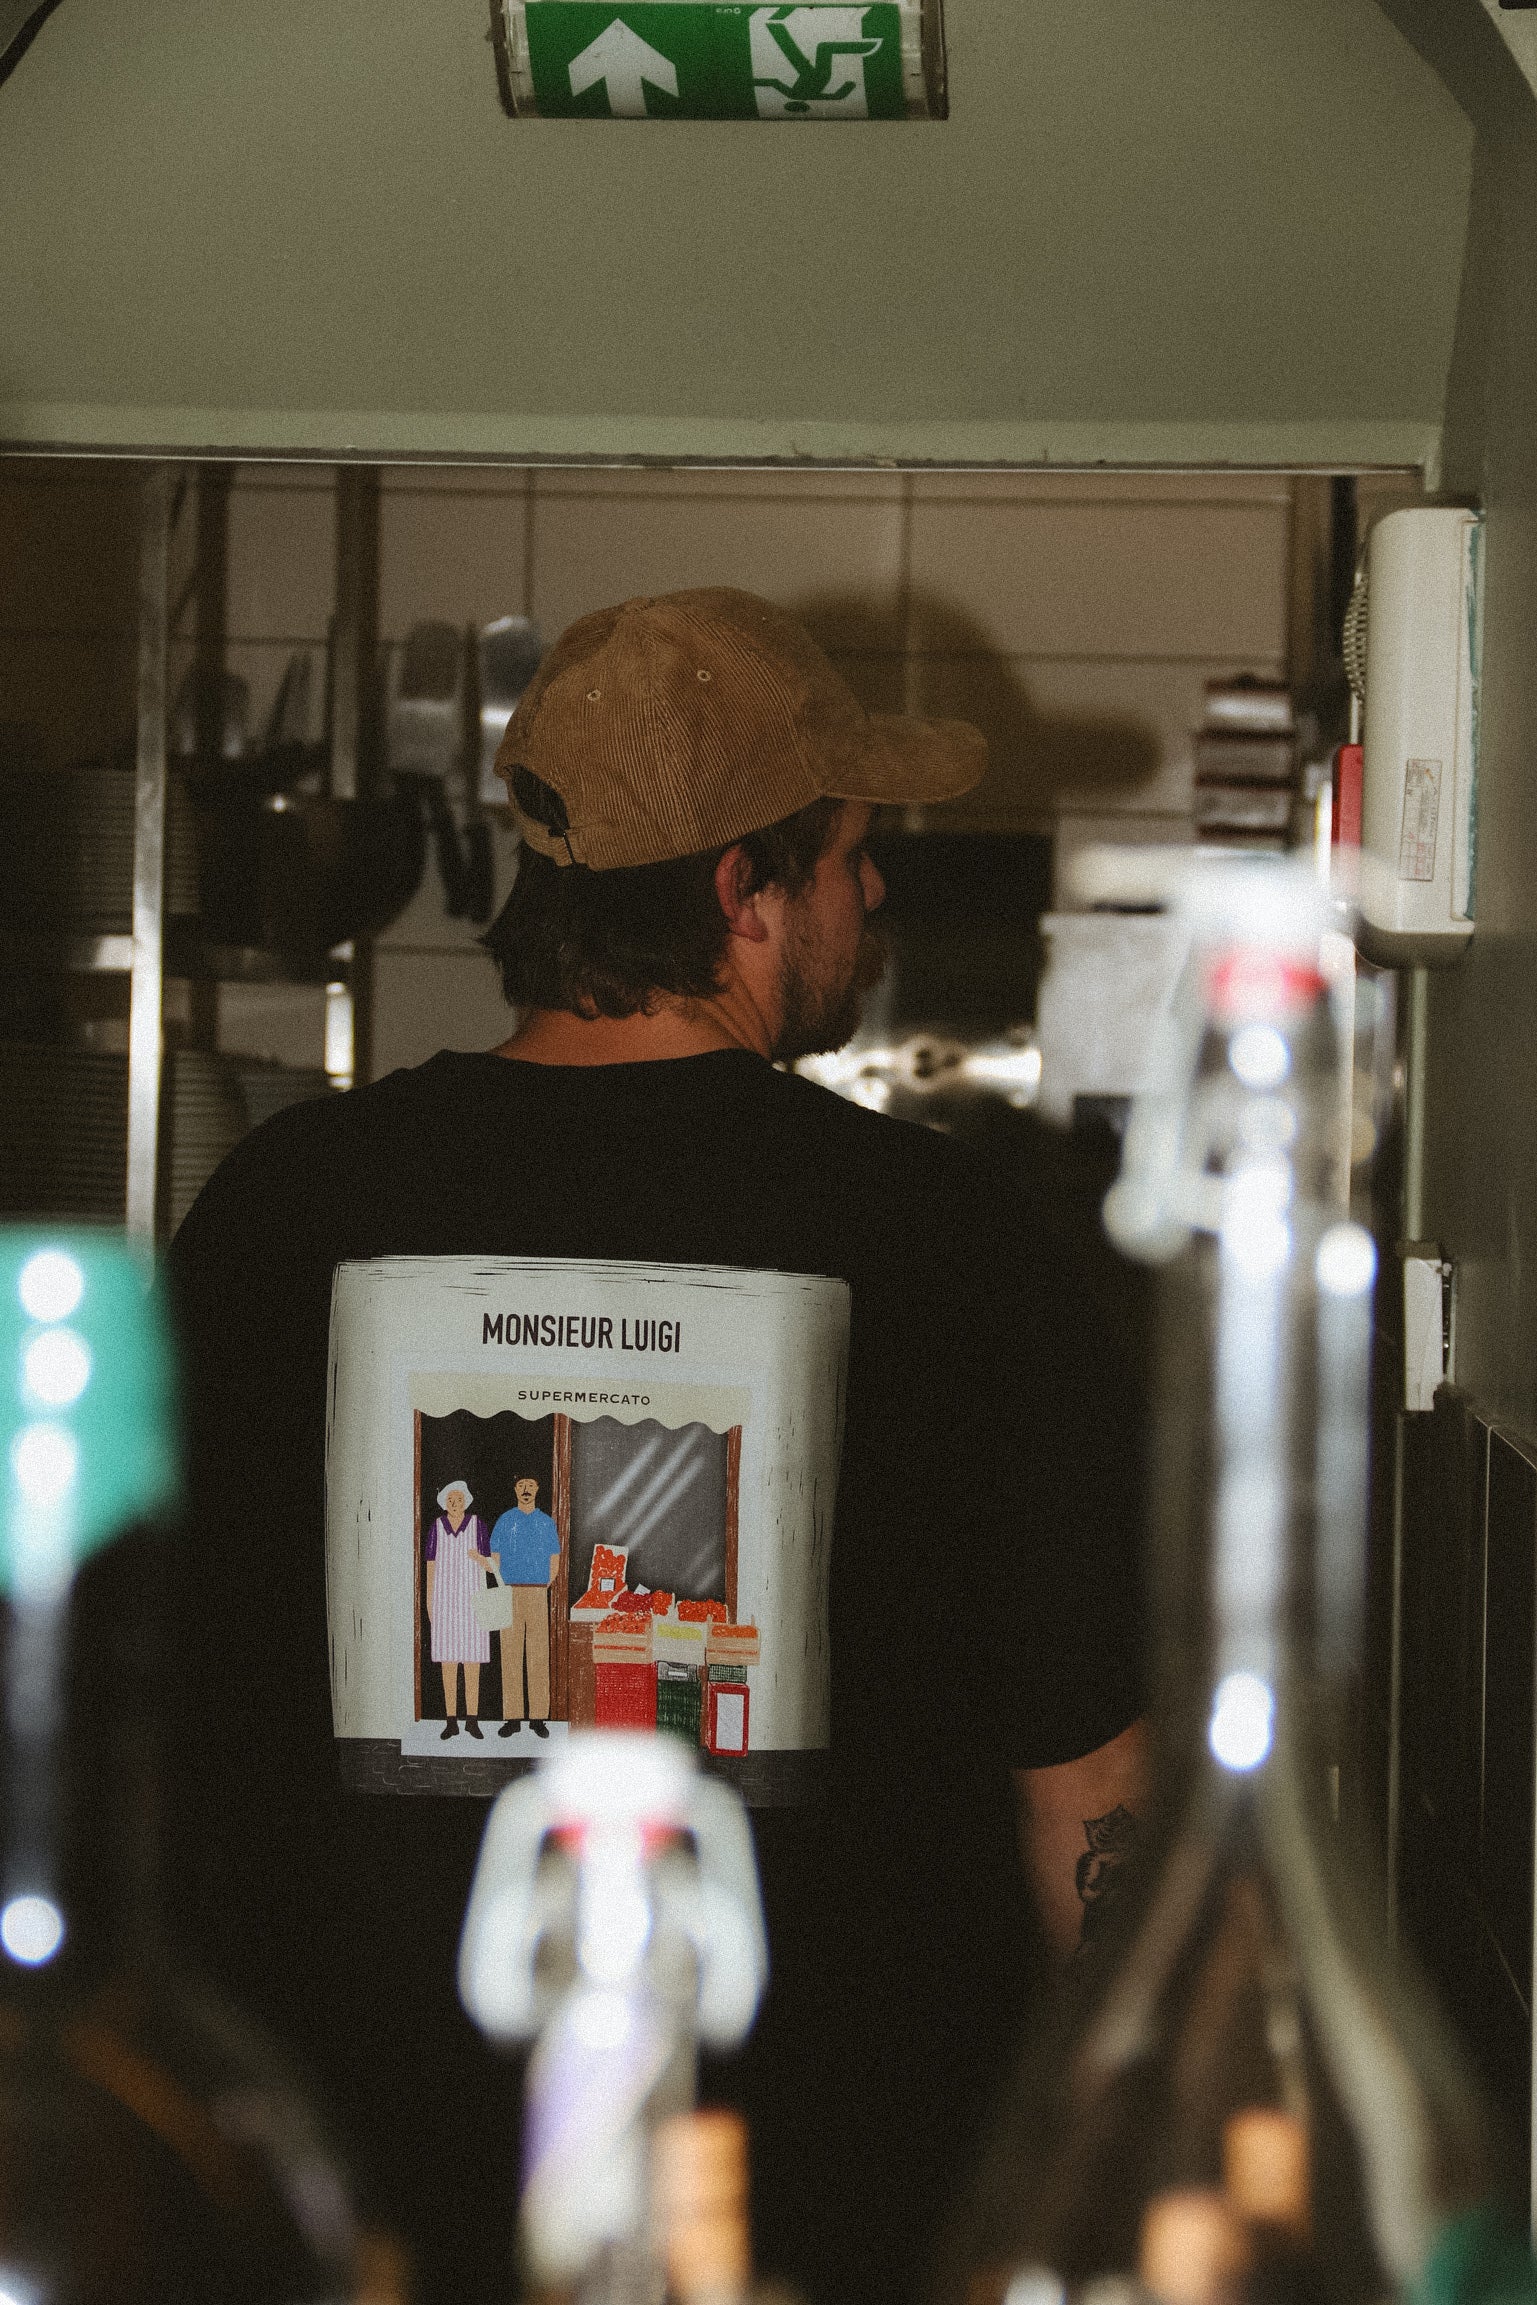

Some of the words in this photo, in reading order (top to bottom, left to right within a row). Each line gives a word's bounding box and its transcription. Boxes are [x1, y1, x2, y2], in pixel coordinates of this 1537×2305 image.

[482, 1312, 614, 1349] MONSIEUR
[621, 1318, 681, 1353] LUIGI
[518, 1390, 651, 1406] SUPERMERCATO
